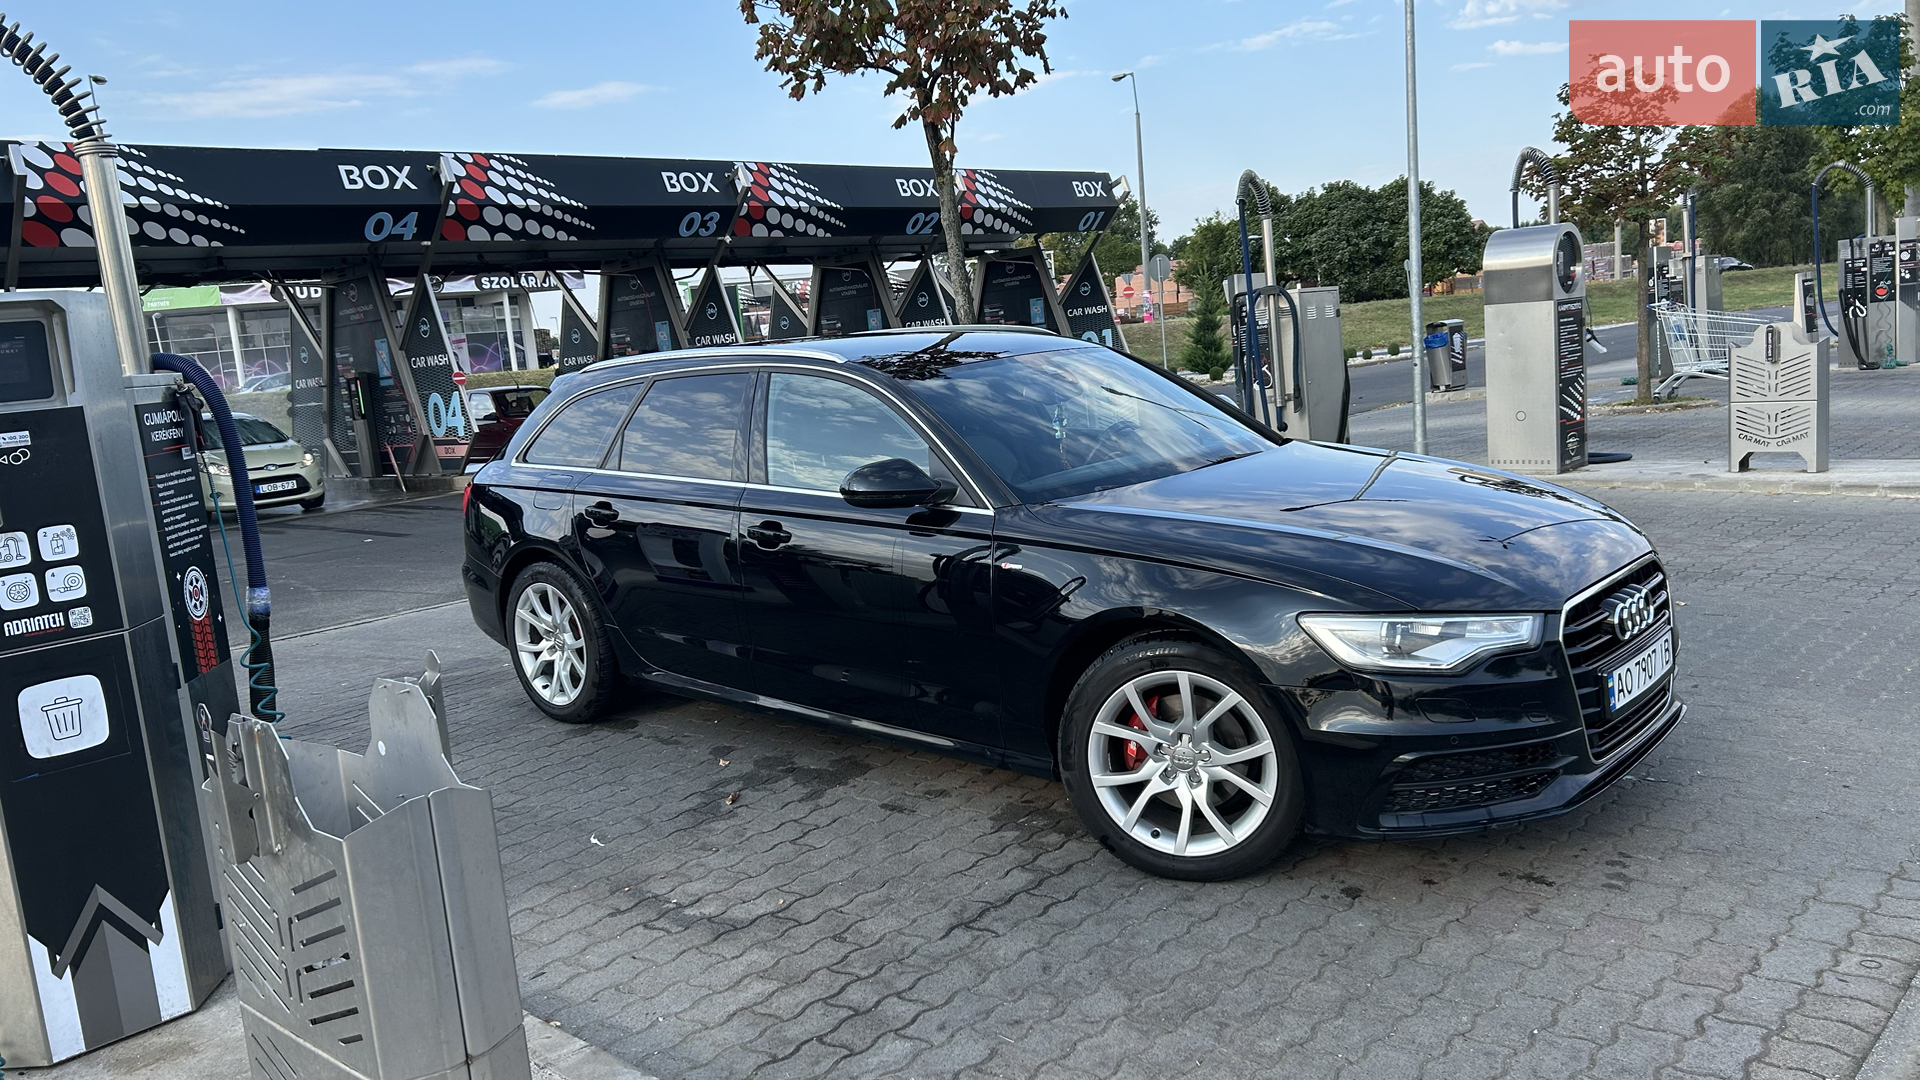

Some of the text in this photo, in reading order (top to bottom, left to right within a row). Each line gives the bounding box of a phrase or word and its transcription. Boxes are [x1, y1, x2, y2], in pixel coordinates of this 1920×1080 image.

[337, 164, 419, 190] BOX
[660, 171, 721, 193] BOX
[895, 178, 940, 197] BOX
[1071, 180, 1108, 198] BOX
[364, 211, 419, 242] 04
[678, 211, 721, 238] 03
[905, 211, 940, 235] 02
[1077, 211, 1106, 232] 01
[1067, 304, 1108, 318] CAR WASH
[922, 317, 946, 327] WASH
[695, 332, 737, 346] CAR WASH
[410, 353, 450, 369] CAR WASH
[564, 354, 597, 366] CAR WASH
[295, 379, 307, 390] CAR
[427, 390, 465, 438] 04
[1738, 431, 1810, 448] CAR MAT CAR MAT
[444, 446, 456, 455] BOX
[260, 480, 296, 494] LOB-673
[1617, 667, 1634, 702] AO
[1634, 648, 1657, 689] 7907
